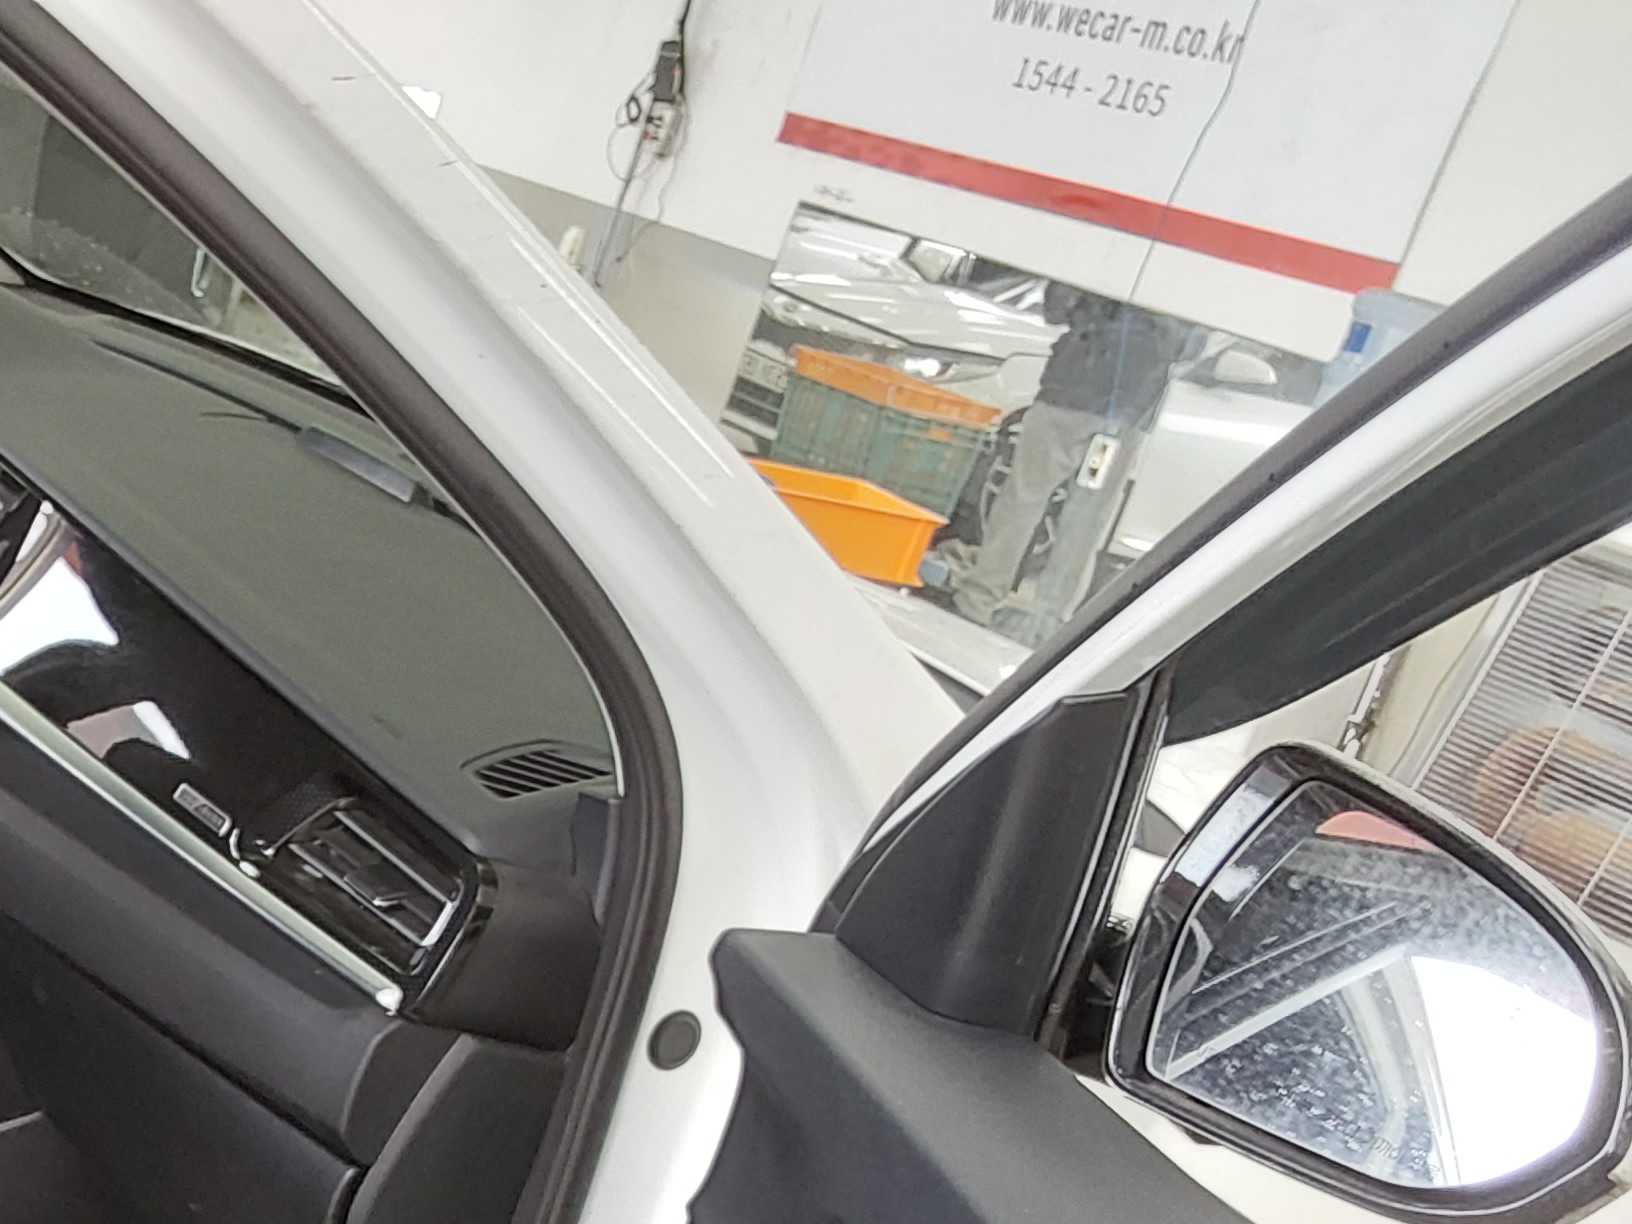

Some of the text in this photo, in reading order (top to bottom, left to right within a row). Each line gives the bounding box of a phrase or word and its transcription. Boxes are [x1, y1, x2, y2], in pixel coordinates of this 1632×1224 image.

[992, 0, 1245, 64] www.wecar-m.co.kr
[1012, 57, 1079, 98] 1544
[1098, 73, 1171, 117] 2165
